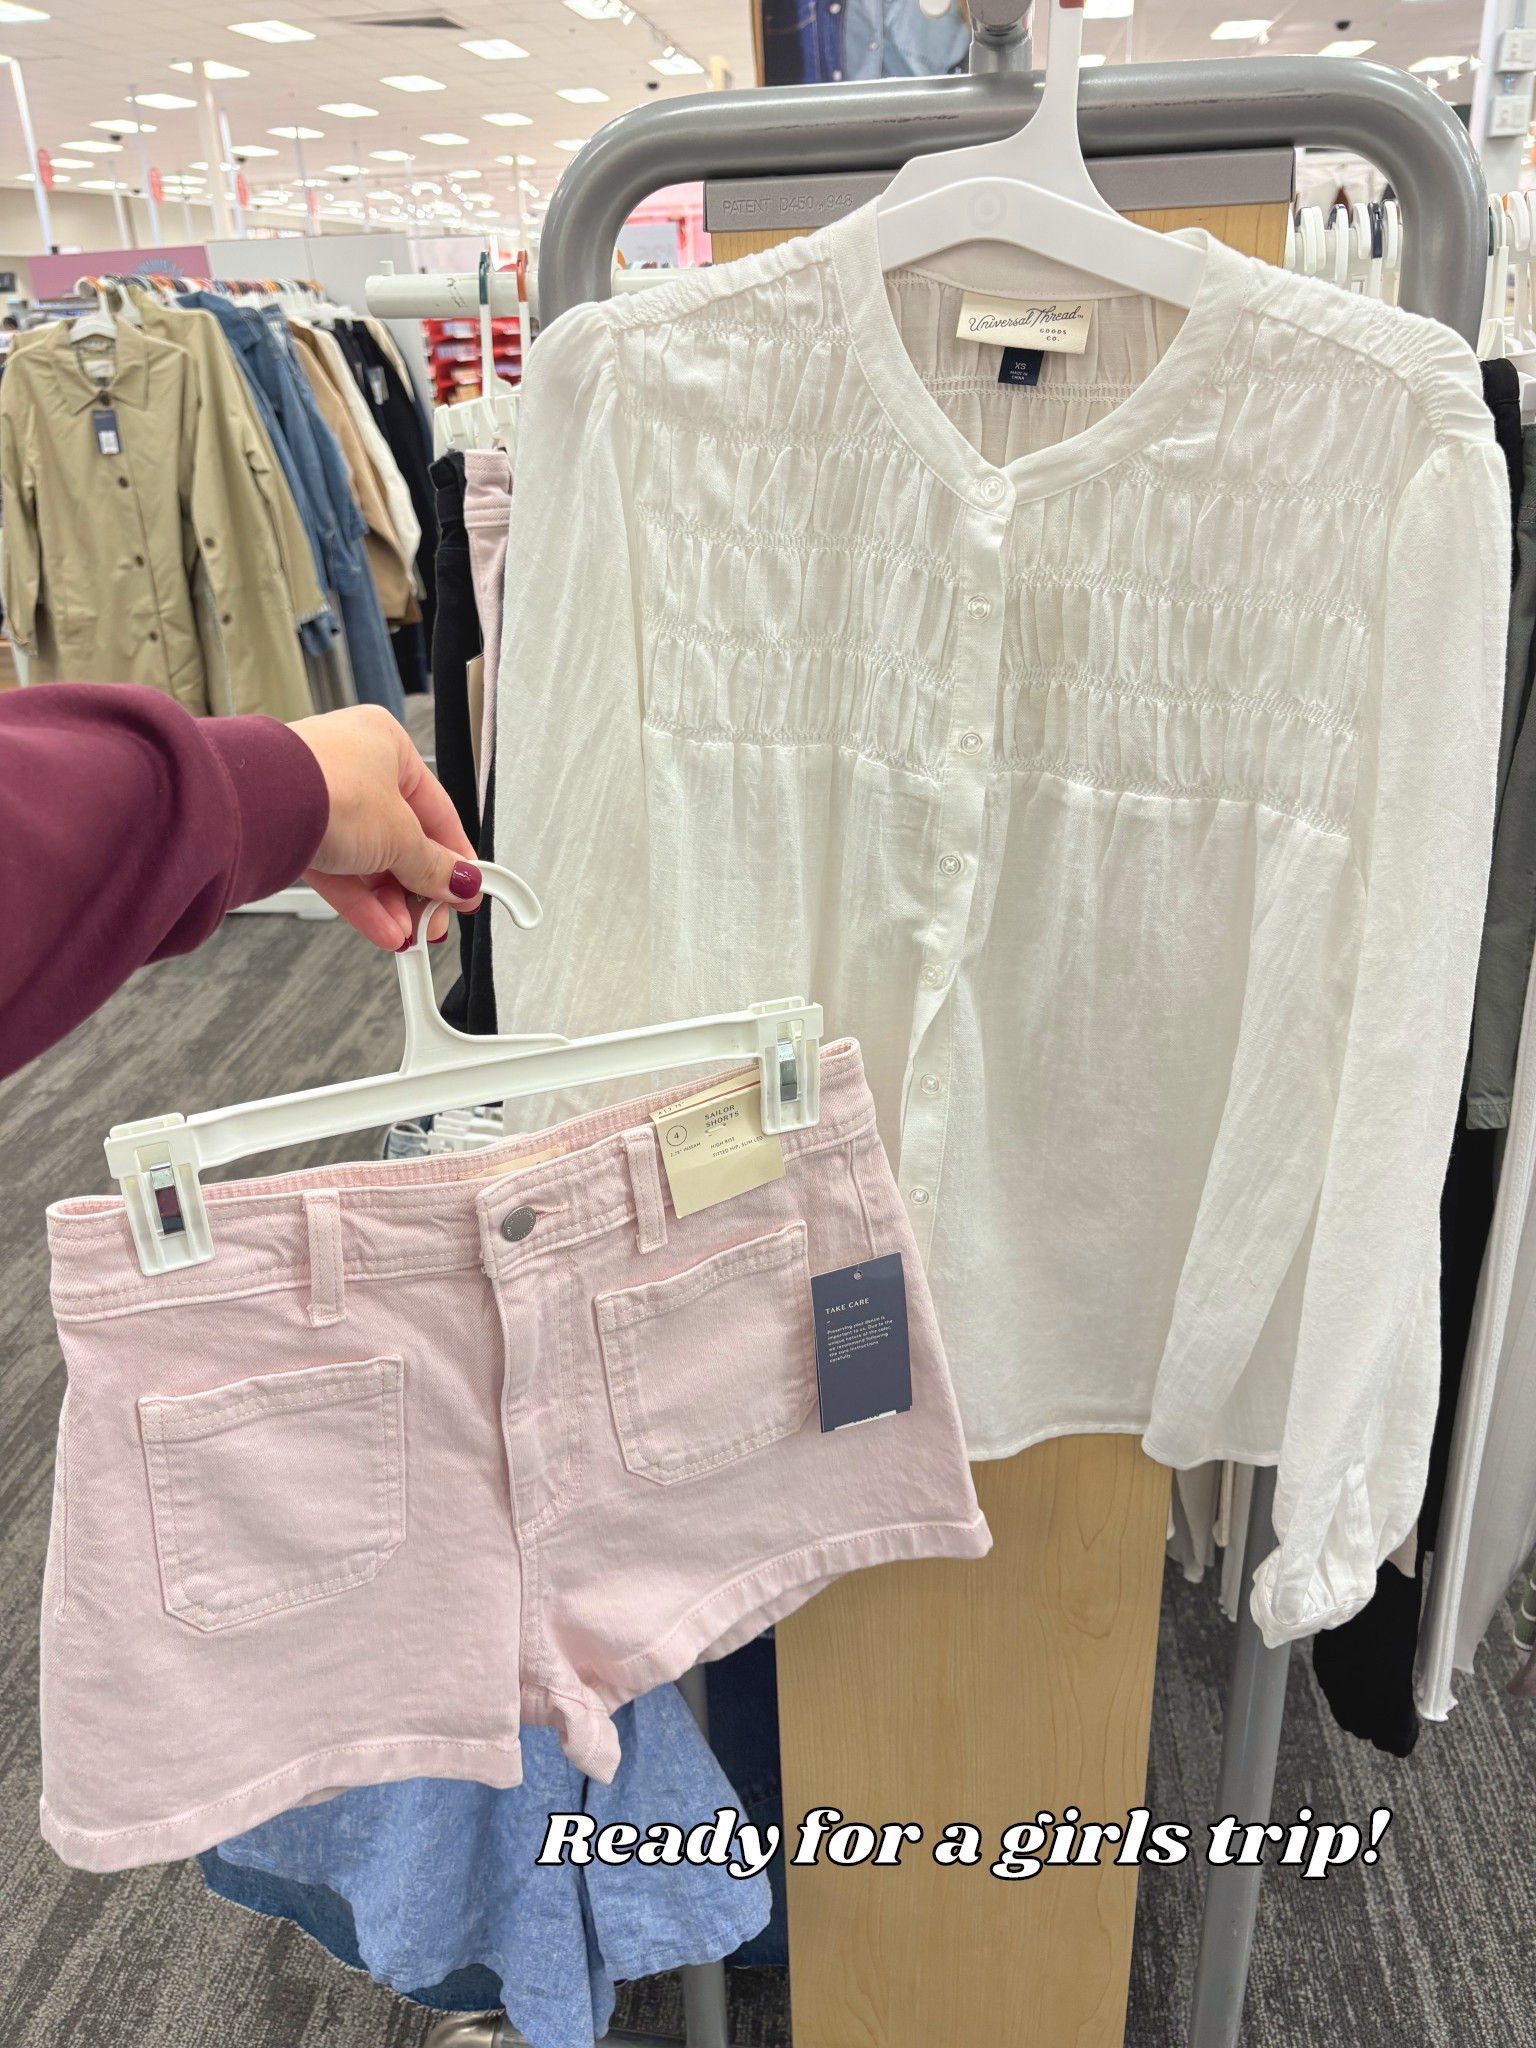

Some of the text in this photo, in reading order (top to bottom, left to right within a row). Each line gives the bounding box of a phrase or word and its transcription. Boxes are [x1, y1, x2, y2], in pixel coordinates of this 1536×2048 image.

[723, 198, 771, 215] PATENT
[968, 311, 1034, 331] Universal
[1014, 361, 1027, 370] XS
[704, 1104, 735, 1120] SAILOR
[705, 1110, 740, 1128] SHORTS
[683, 1142, 701, 1152] INSEAM
[710, 1136, 736, 1149] HIGH RISE
[712, 1148, 729, 1158] FITTED
[741, 1139, 753, 1147] SLIM
[753, 1135, 764, 1143] LEG
[825, 1297, 870, 1315] TAKE CARE
[853, 1321, 864, 1329] your
[865, 1316, 880, 1324] denim
[828, 1330, 852, 1341] important
[828, 1338, 845, 1346] unique
[845, 1334, 862, 1342] nature
[836, 1338, 865, 1350] recommend
[865, 1332, 889, 1341] following
